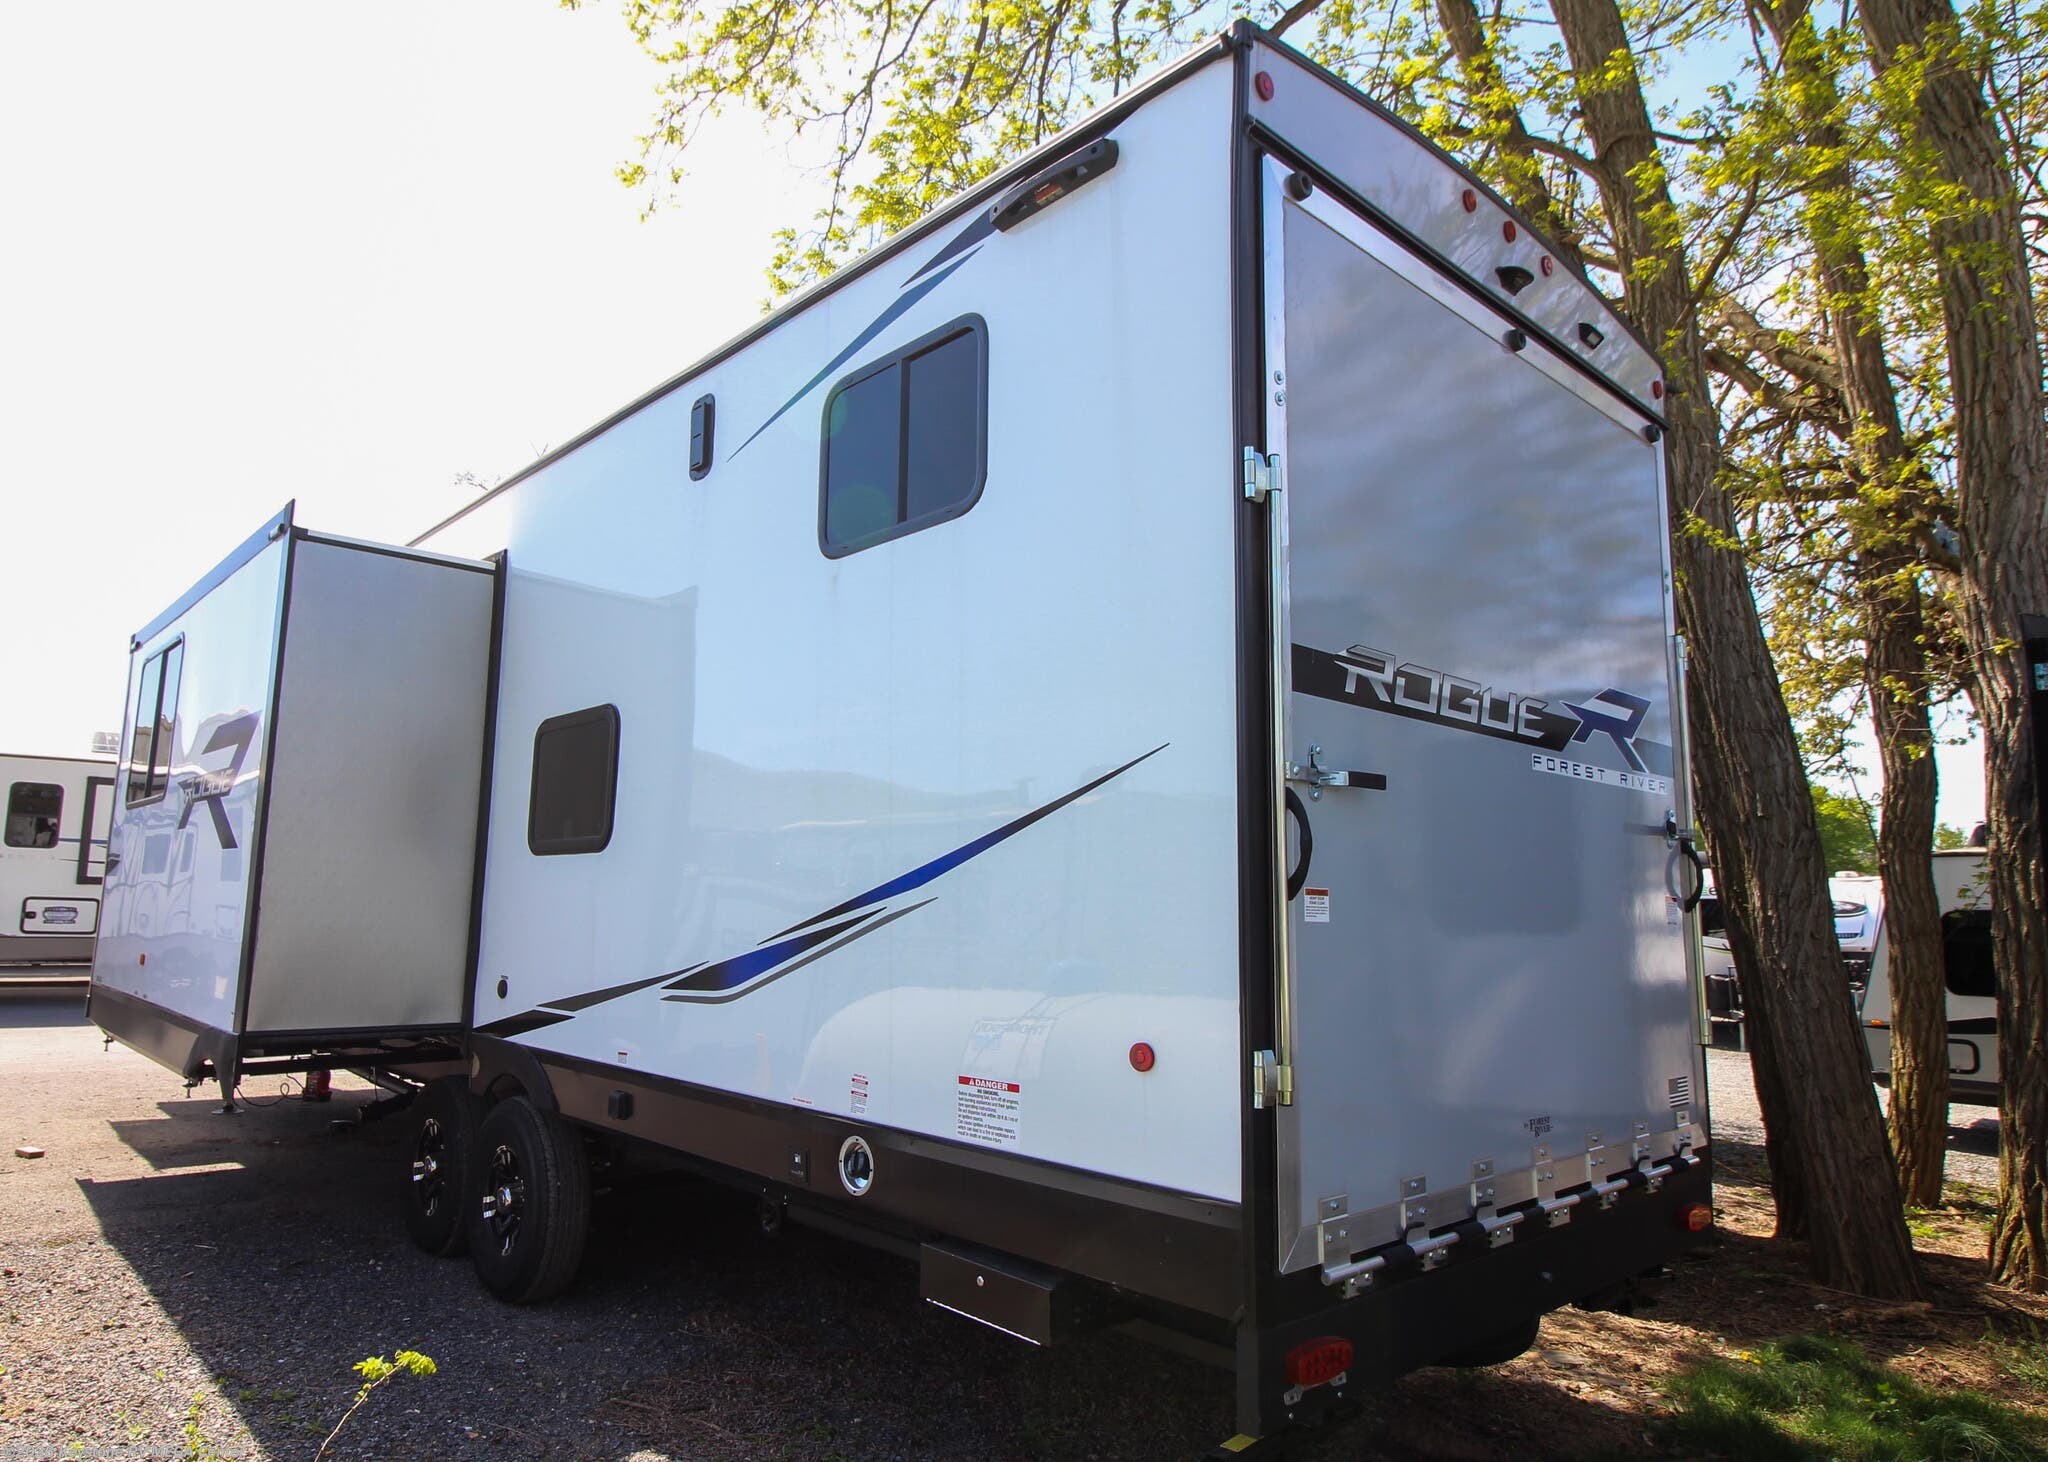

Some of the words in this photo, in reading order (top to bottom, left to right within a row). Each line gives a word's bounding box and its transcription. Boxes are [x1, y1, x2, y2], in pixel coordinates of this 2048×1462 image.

[1334, 644, 1549, 739] ROGUE
[1532, 755, 1606, 781] FOREST
[1620, 773, 1667, 792] RIVER
[975, 1079, 1008, 1091] DANGER
